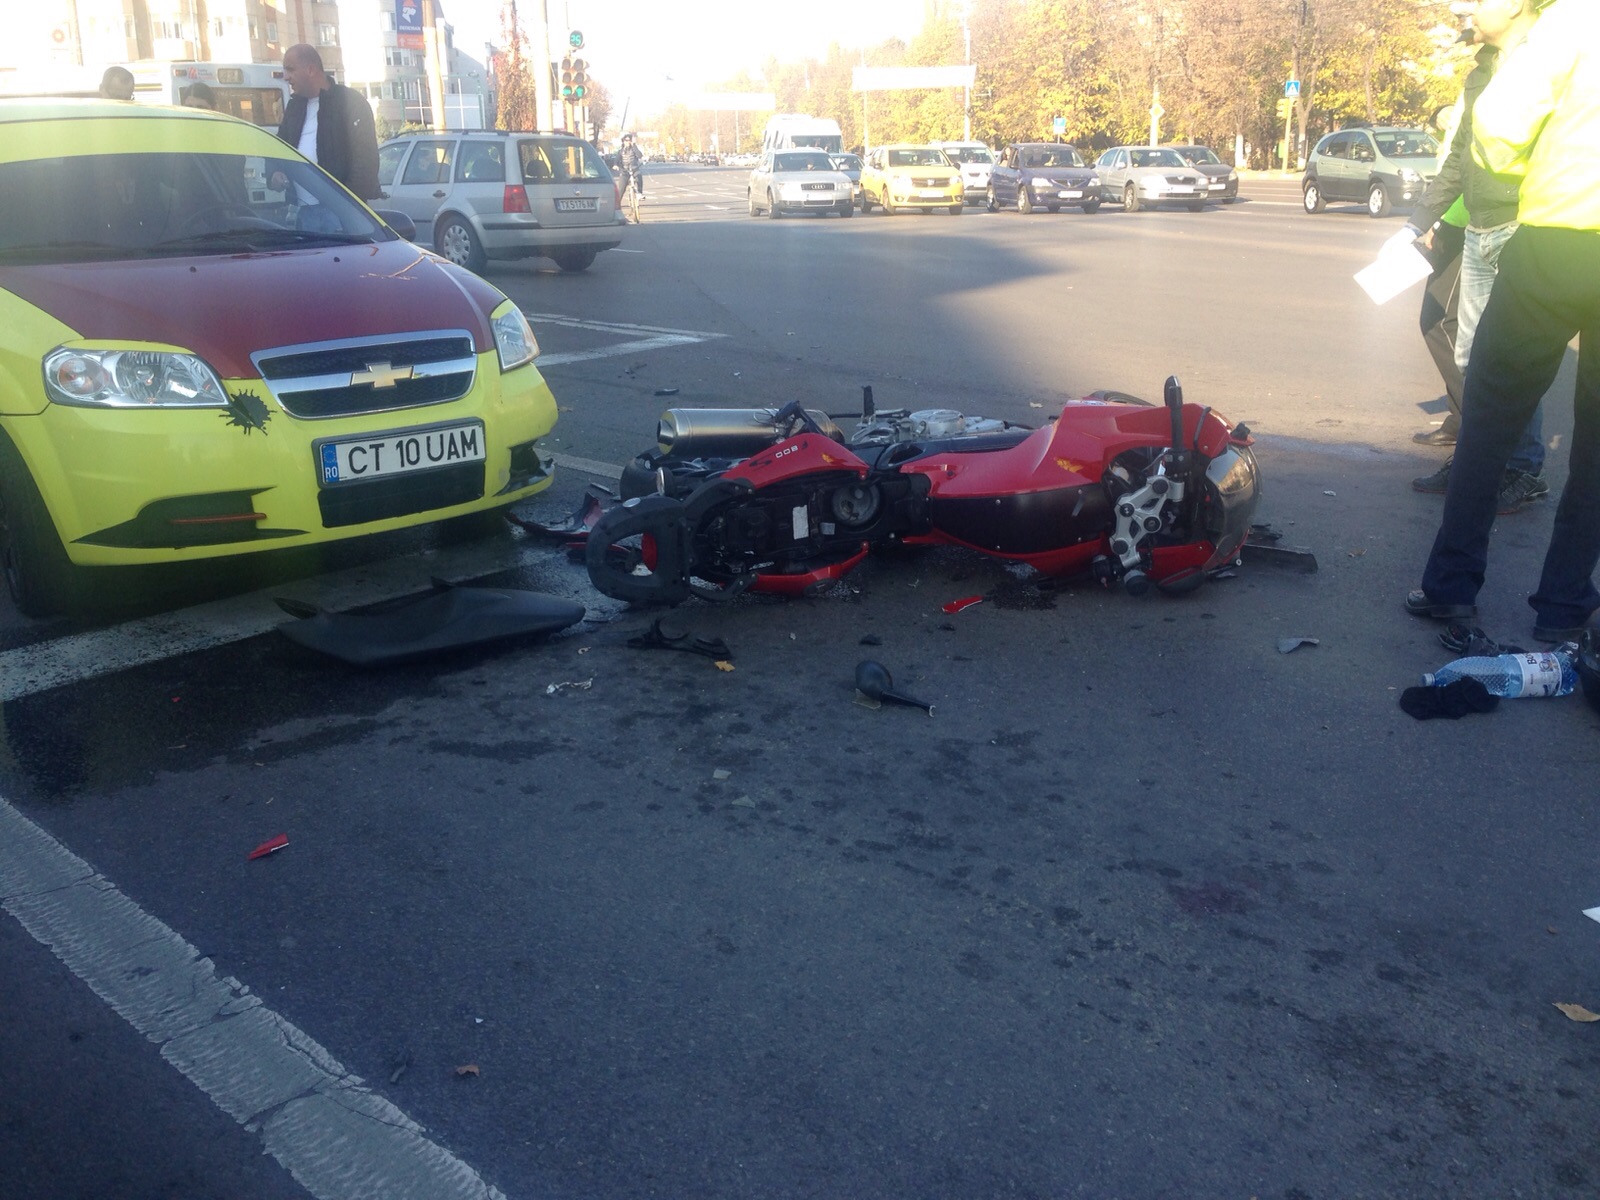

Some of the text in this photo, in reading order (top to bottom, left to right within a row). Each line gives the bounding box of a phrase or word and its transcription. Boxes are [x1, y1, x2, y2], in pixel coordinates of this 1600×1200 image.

[348, 428, 478, 474] CT 10 UAM
[325, 466, 338, 479] RO
